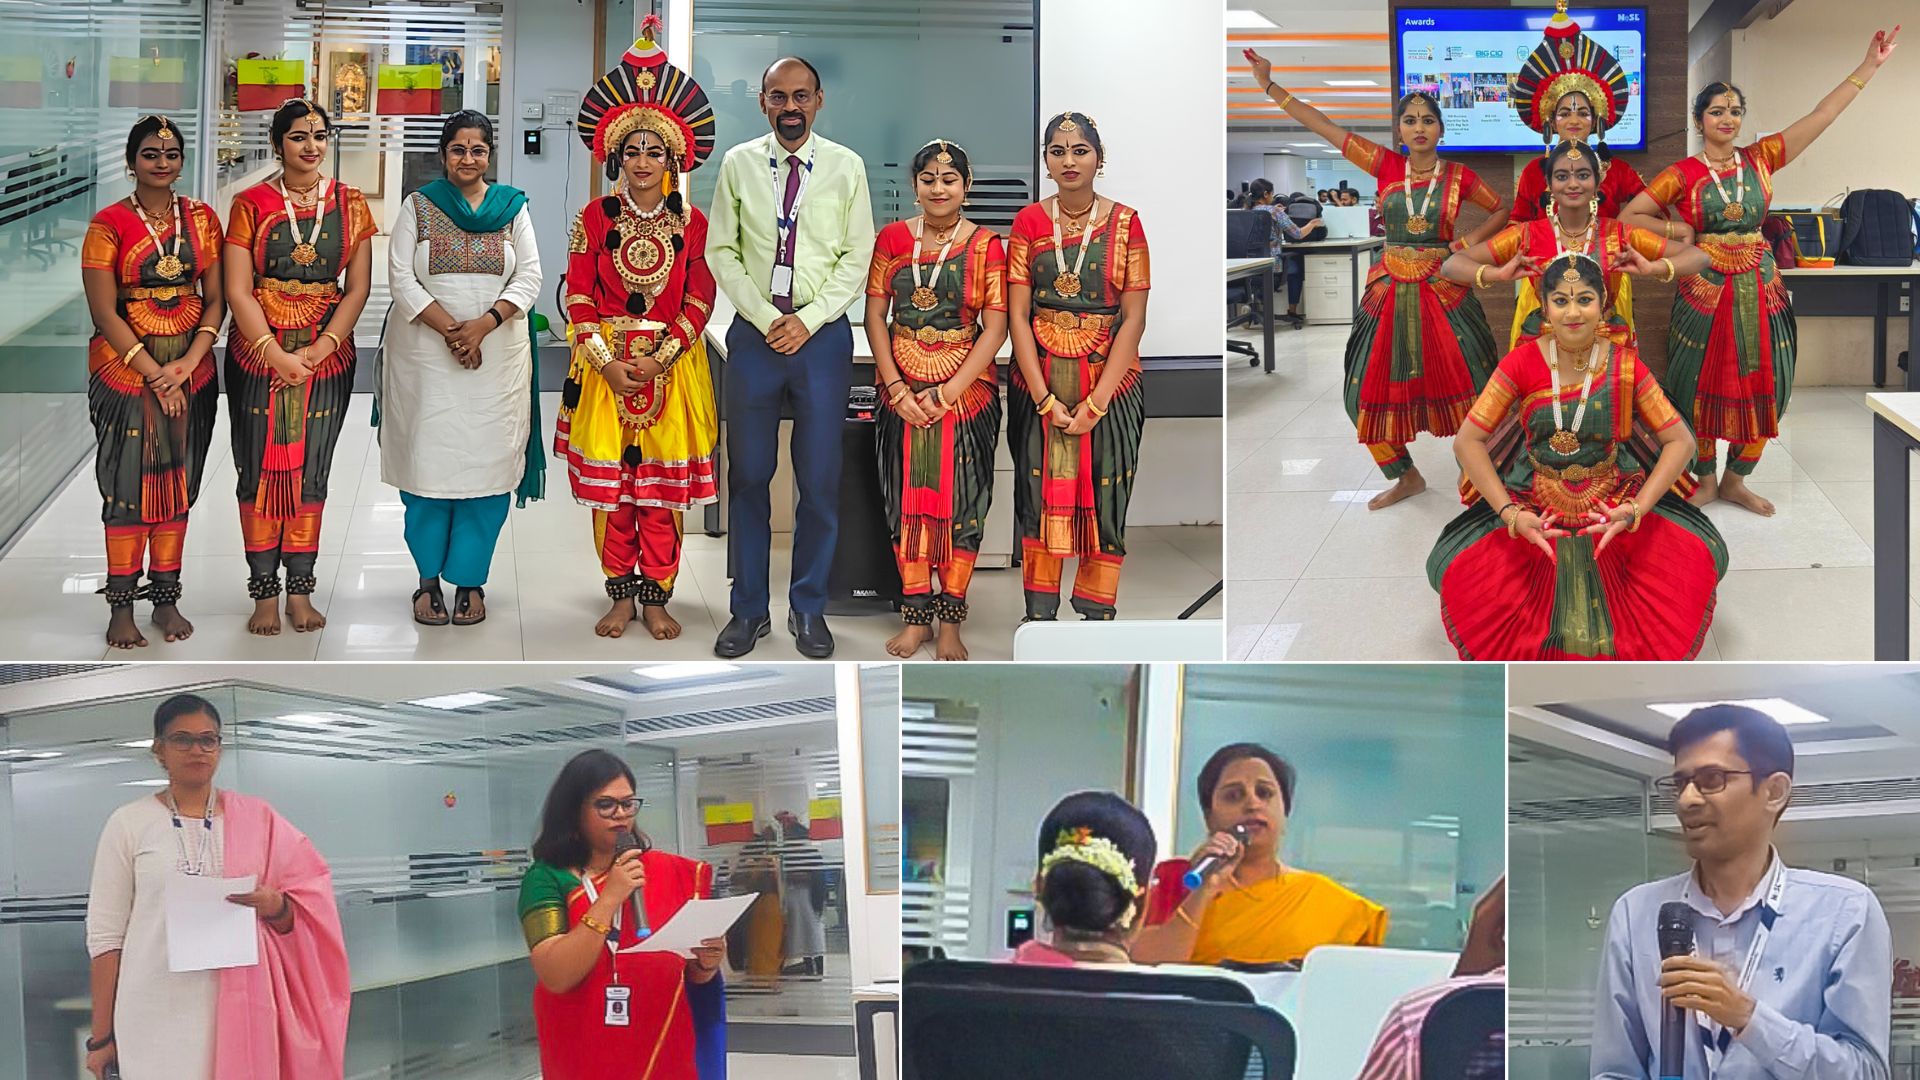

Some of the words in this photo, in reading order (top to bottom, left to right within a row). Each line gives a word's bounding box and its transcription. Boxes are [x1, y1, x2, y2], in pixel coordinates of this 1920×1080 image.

[1405, 18, 1435, 26] Awards
[1475, 50, 1489, 58] BIG
[1490, 50, 1503, 58] CIO
